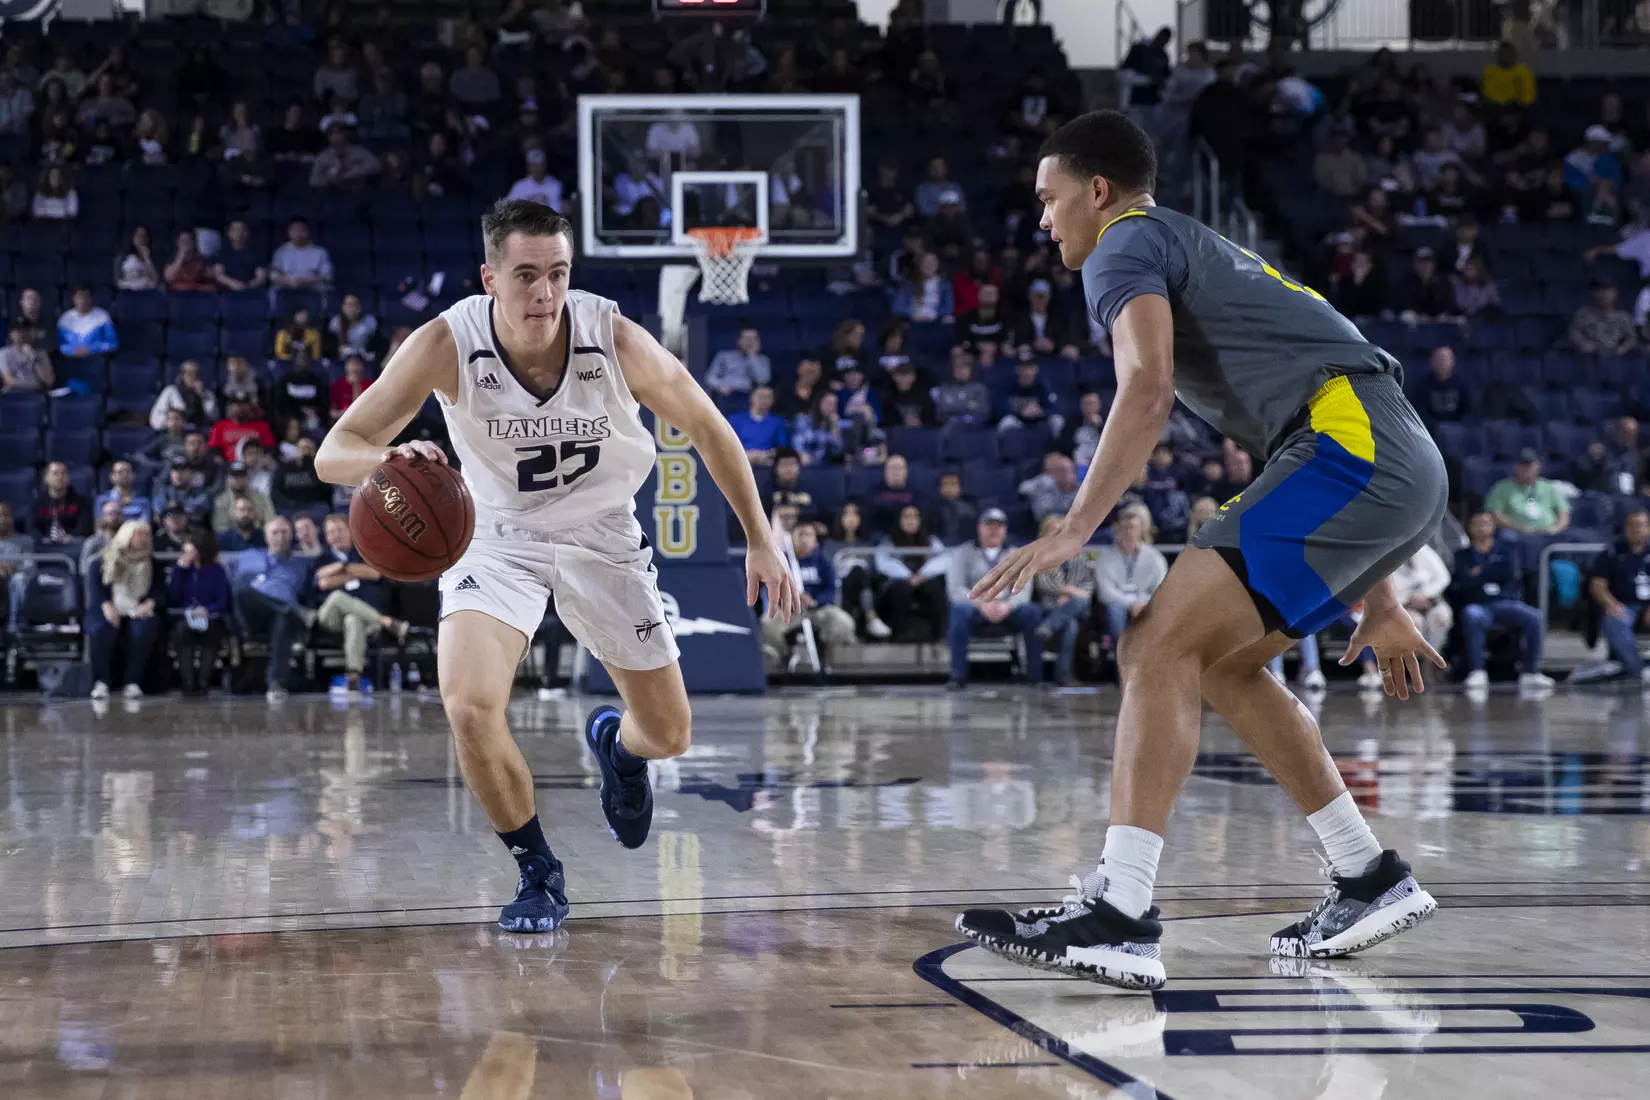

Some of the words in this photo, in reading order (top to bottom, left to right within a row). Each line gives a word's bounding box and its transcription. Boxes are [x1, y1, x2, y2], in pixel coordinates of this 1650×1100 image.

[576, 367, 603, 382] WAC
[476, 380, 502, 390] adidas
[486, 416, 611, 439] LANCERS
[515, 439, 603, 492] 25
[371, 468, 426, 543] Wilson
[454, 582, 480, 591] adidas
